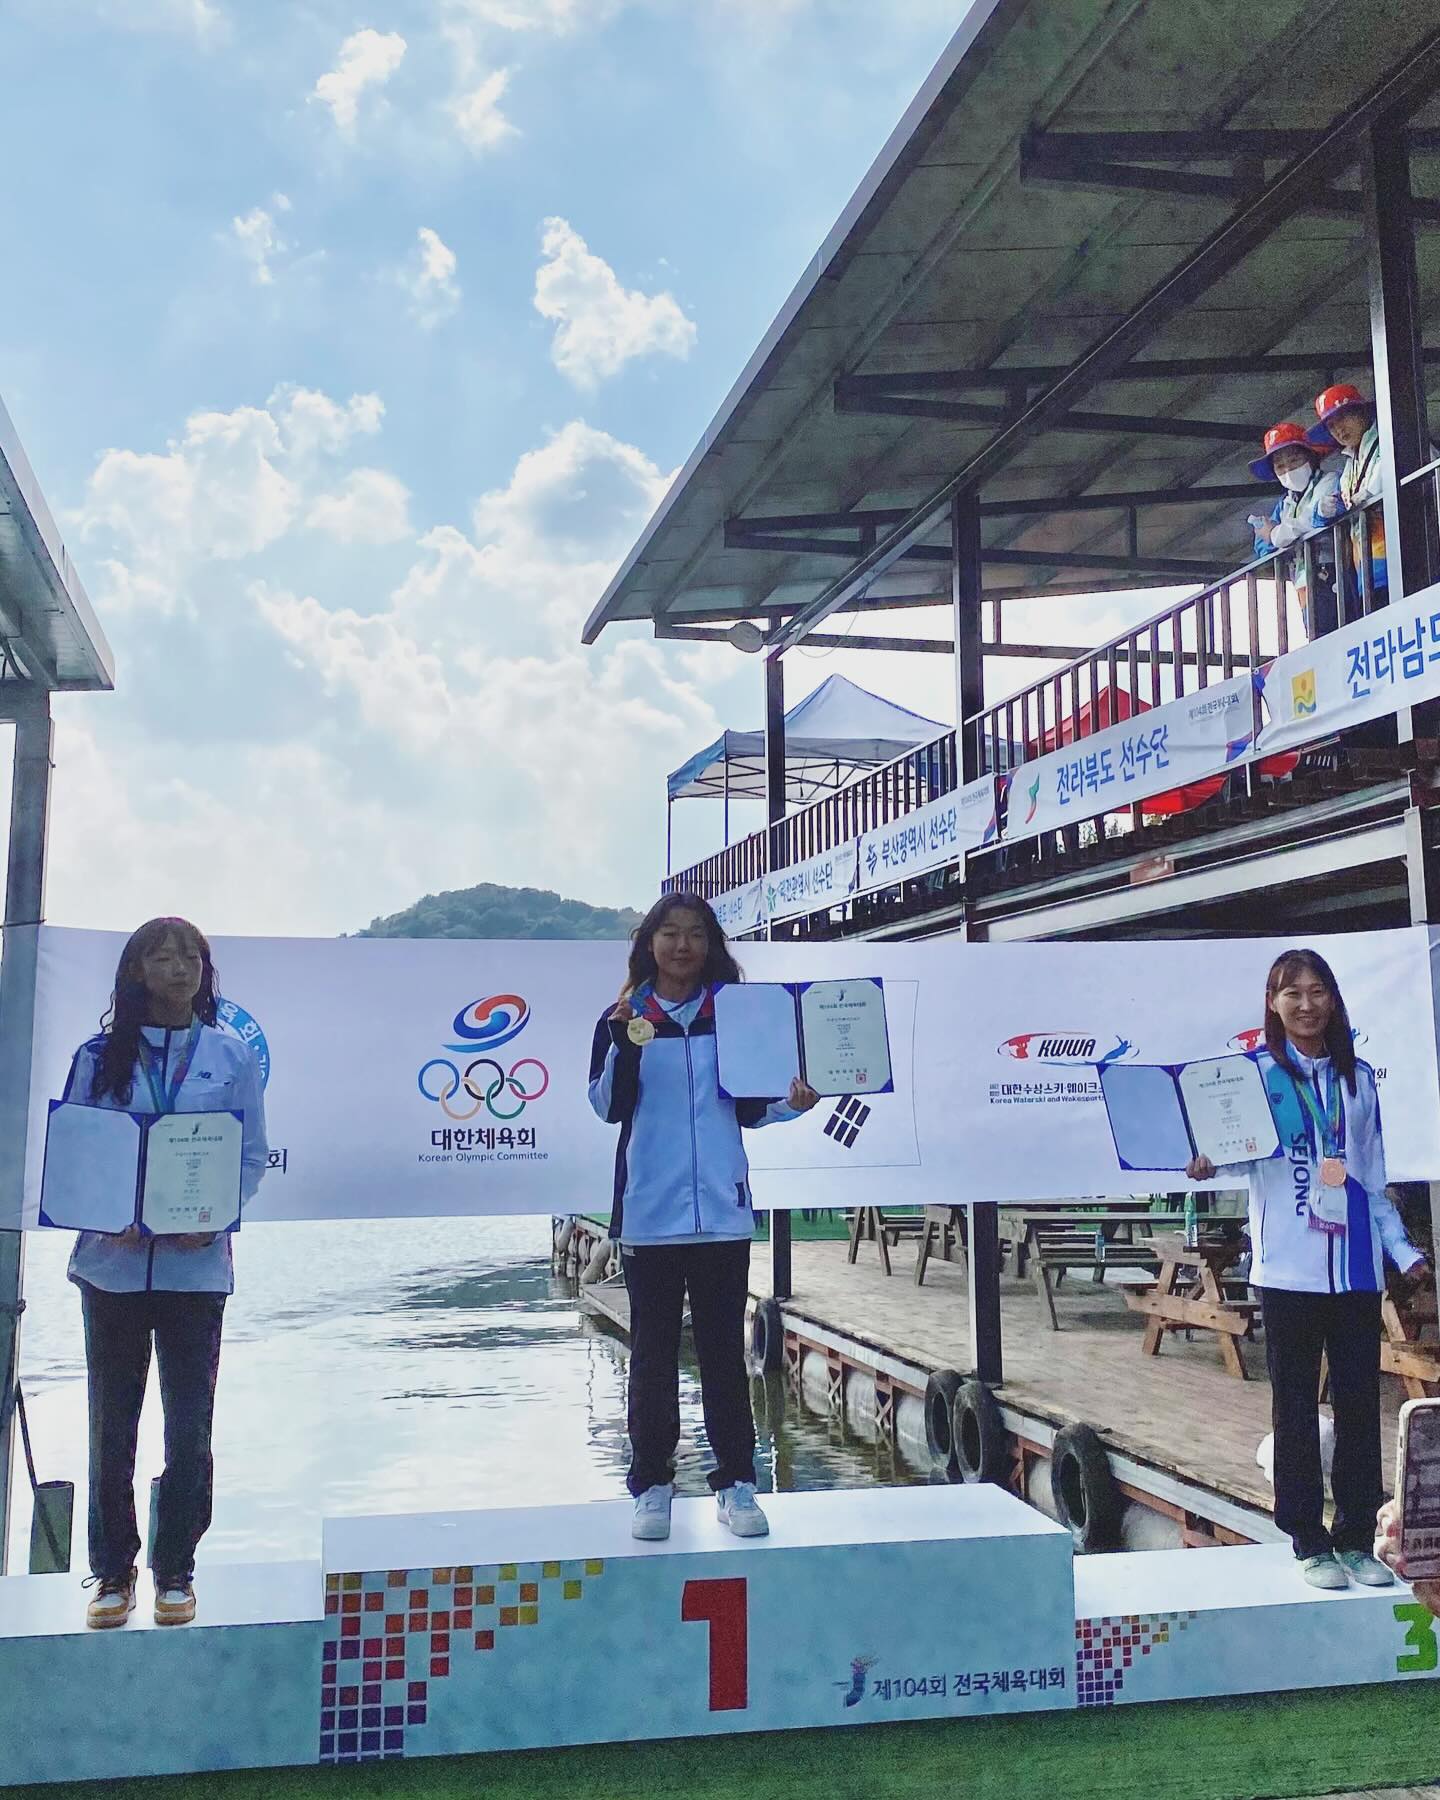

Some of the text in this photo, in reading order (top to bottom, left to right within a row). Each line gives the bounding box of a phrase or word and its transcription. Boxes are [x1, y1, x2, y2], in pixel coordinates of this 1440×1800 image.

[1056, 724, 1170, 805] 전라북도 선수단
[881, 807, 957, 868] 부산광역시 선수단
[1037, 1038, 1097, 1058] KWWA
[990, 1096, 1012, 1105] Korea
[1013, 1095, 1046, 1104] Waterski
[1047, 1094, 1061, 1103] and
[418, 1151, 549, 1163] Korean Olympic Committee
[431, 1127, 536, 1151] 대한체육회
[1289, 1132, 1311, 1217] SEJONG
[681, 1577, 748, 1712] 1
[1392, 1602, 1438, 1673] 3
[871, 1666, 1066, 1701] 제104회 전국체육대회
